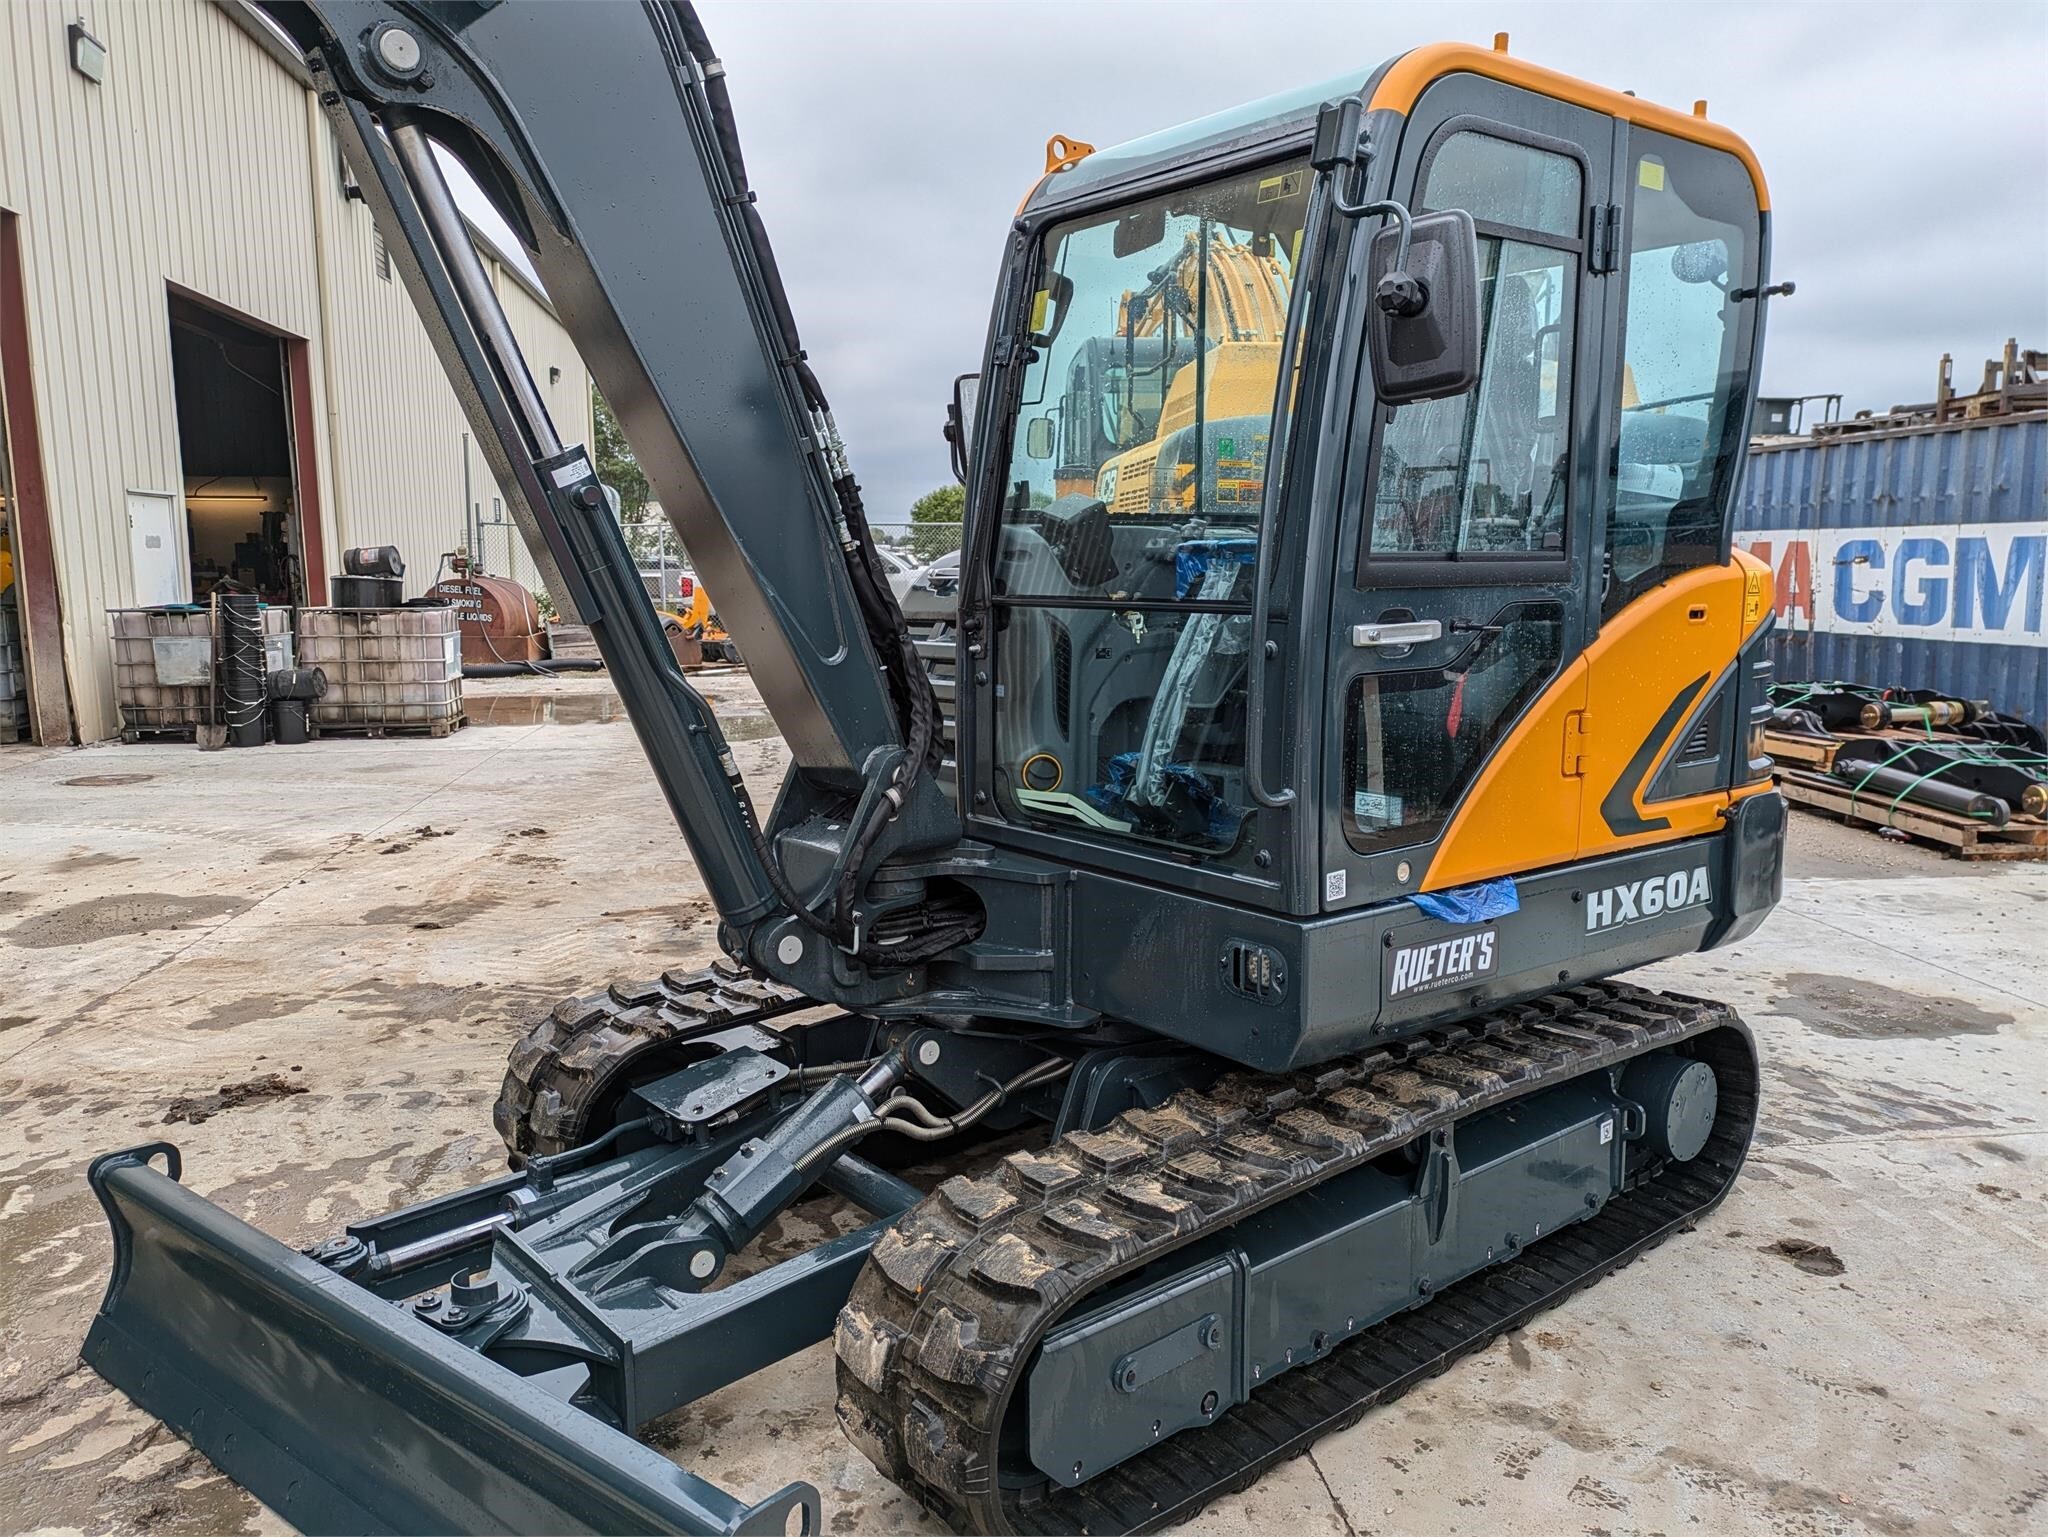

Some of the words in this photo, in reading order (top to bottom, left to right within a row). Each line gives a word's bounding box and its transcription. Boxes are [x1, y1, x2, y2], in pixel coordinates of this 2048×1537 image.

[439, 585, 463, 594] DIESEL
[465, 586, 482, 595] FUEL
[1833, 536, 2047, 633] CGM
[1586, 866, 1710, 930] HX60A
[1391, 931, 1495, 996] RUETER'S
[1413, 972, 1474, 993] www.rueterco.com
